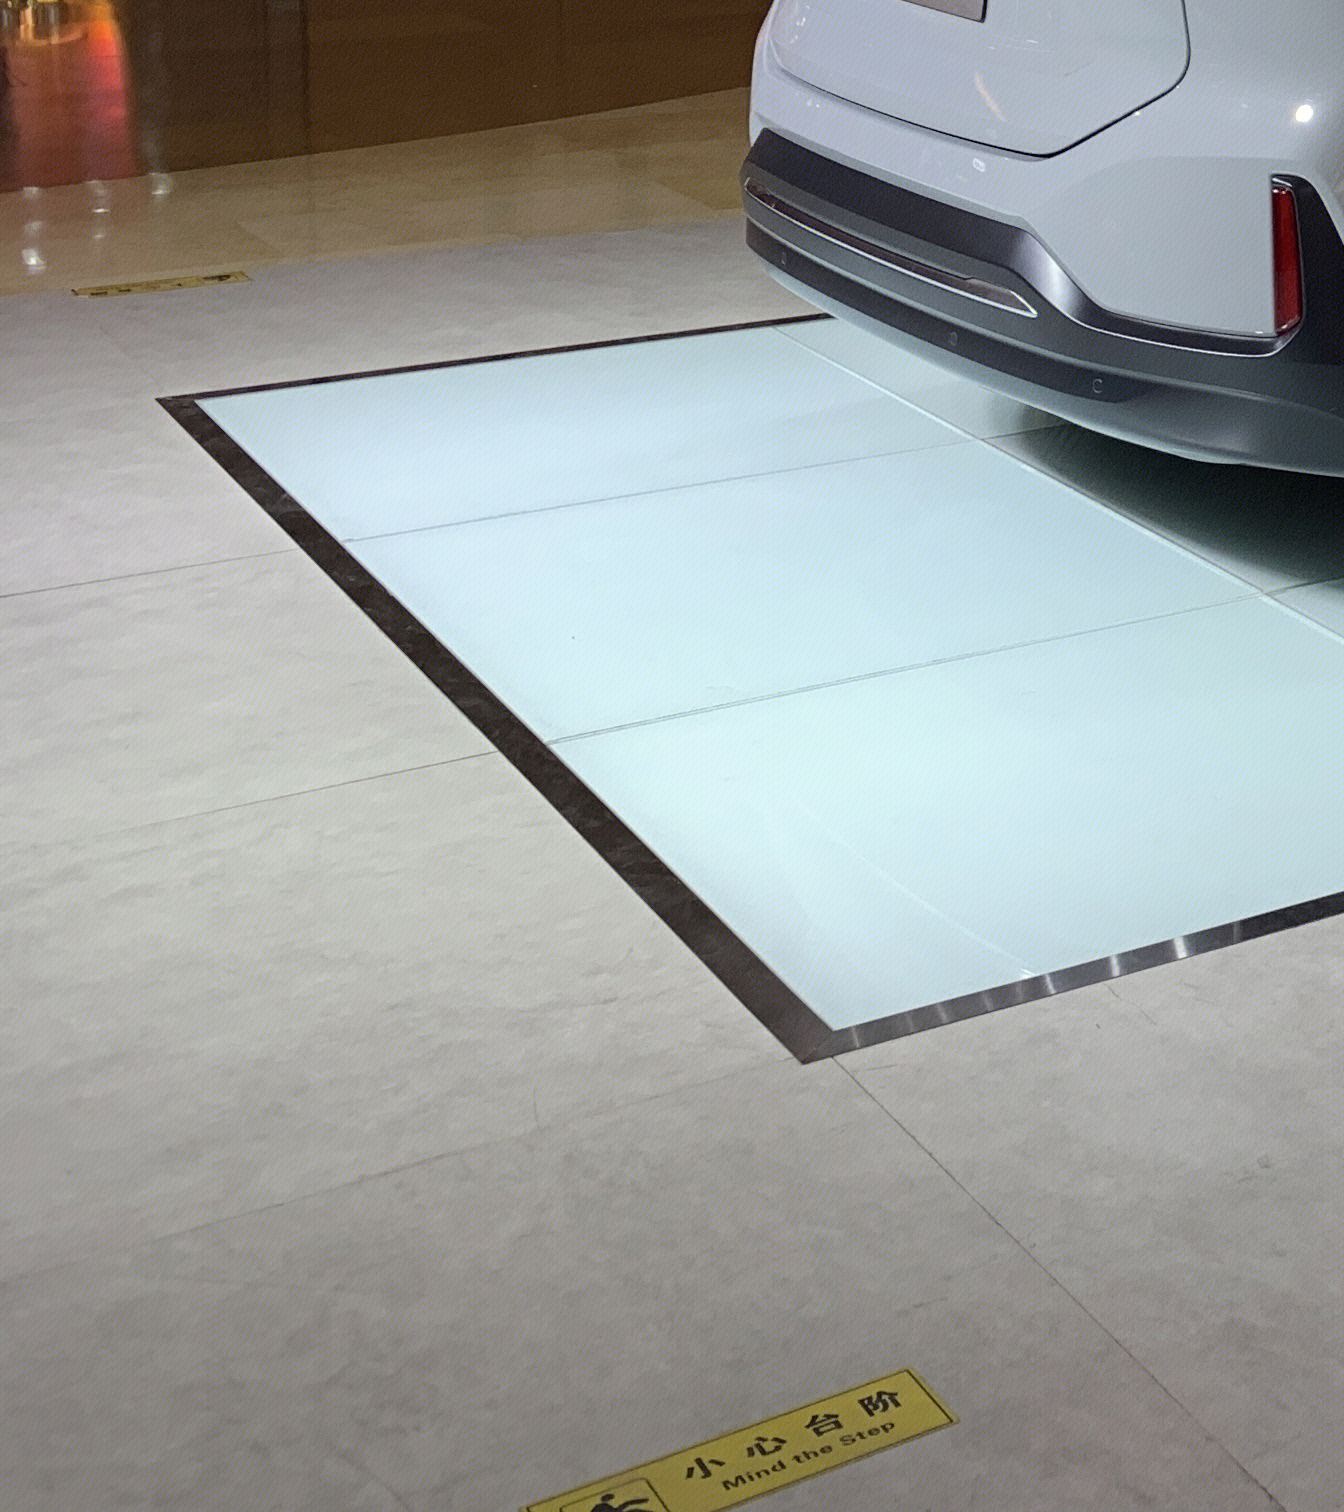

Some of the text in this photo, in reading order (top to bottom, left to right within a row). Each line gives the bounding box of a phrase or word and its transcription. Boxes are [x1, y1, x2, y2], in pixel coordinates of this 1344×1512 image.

[685, 1389, 901, 1482] 小心台阶
[721, 1420, 897, 1492] Mind the Step
